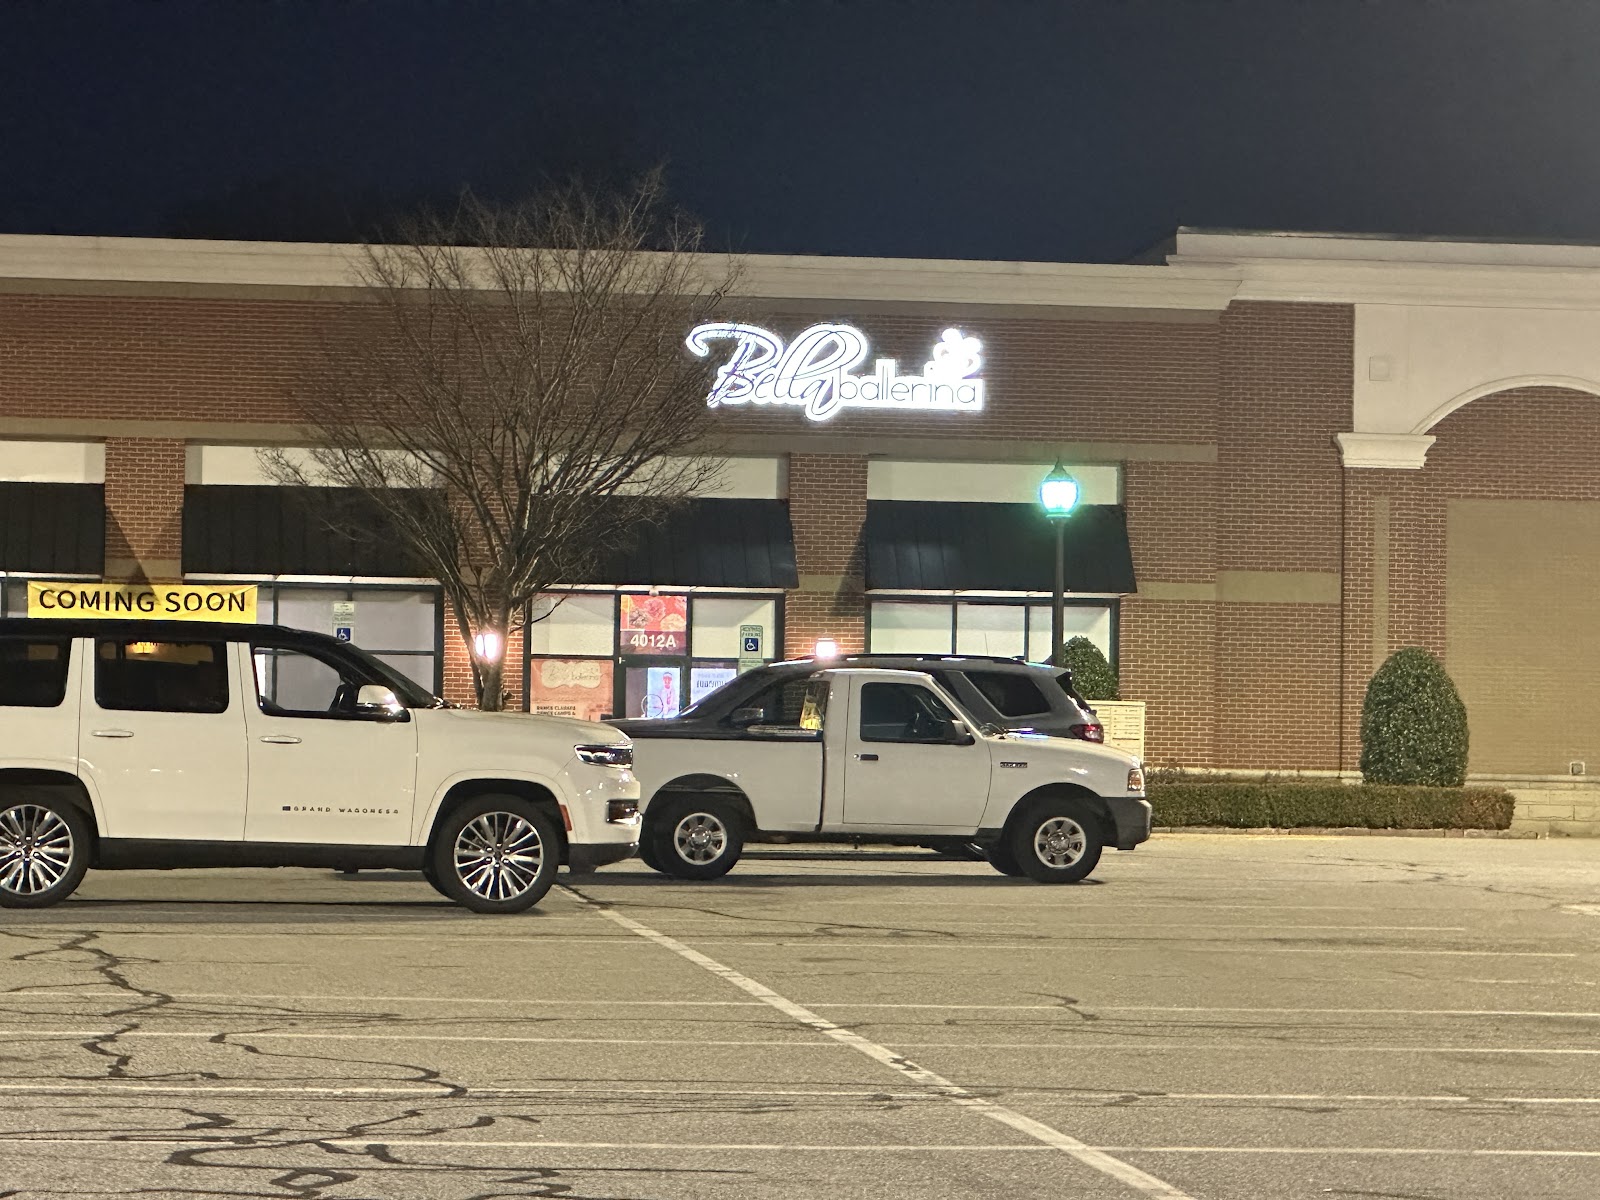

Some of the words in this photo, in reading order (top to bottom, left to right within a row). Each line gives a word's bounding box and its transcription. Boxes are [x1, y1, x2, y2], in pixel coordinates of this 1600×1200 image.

[687, 324, 866, 419] Bella
[838, 360, 982, 408] ballerina
[38, 589, 155, 612] COMING
[165, 591, 246, 613] SOON
[630, 633, 677, 648] 4012A
[293, 805, 331, 813] GRAND
